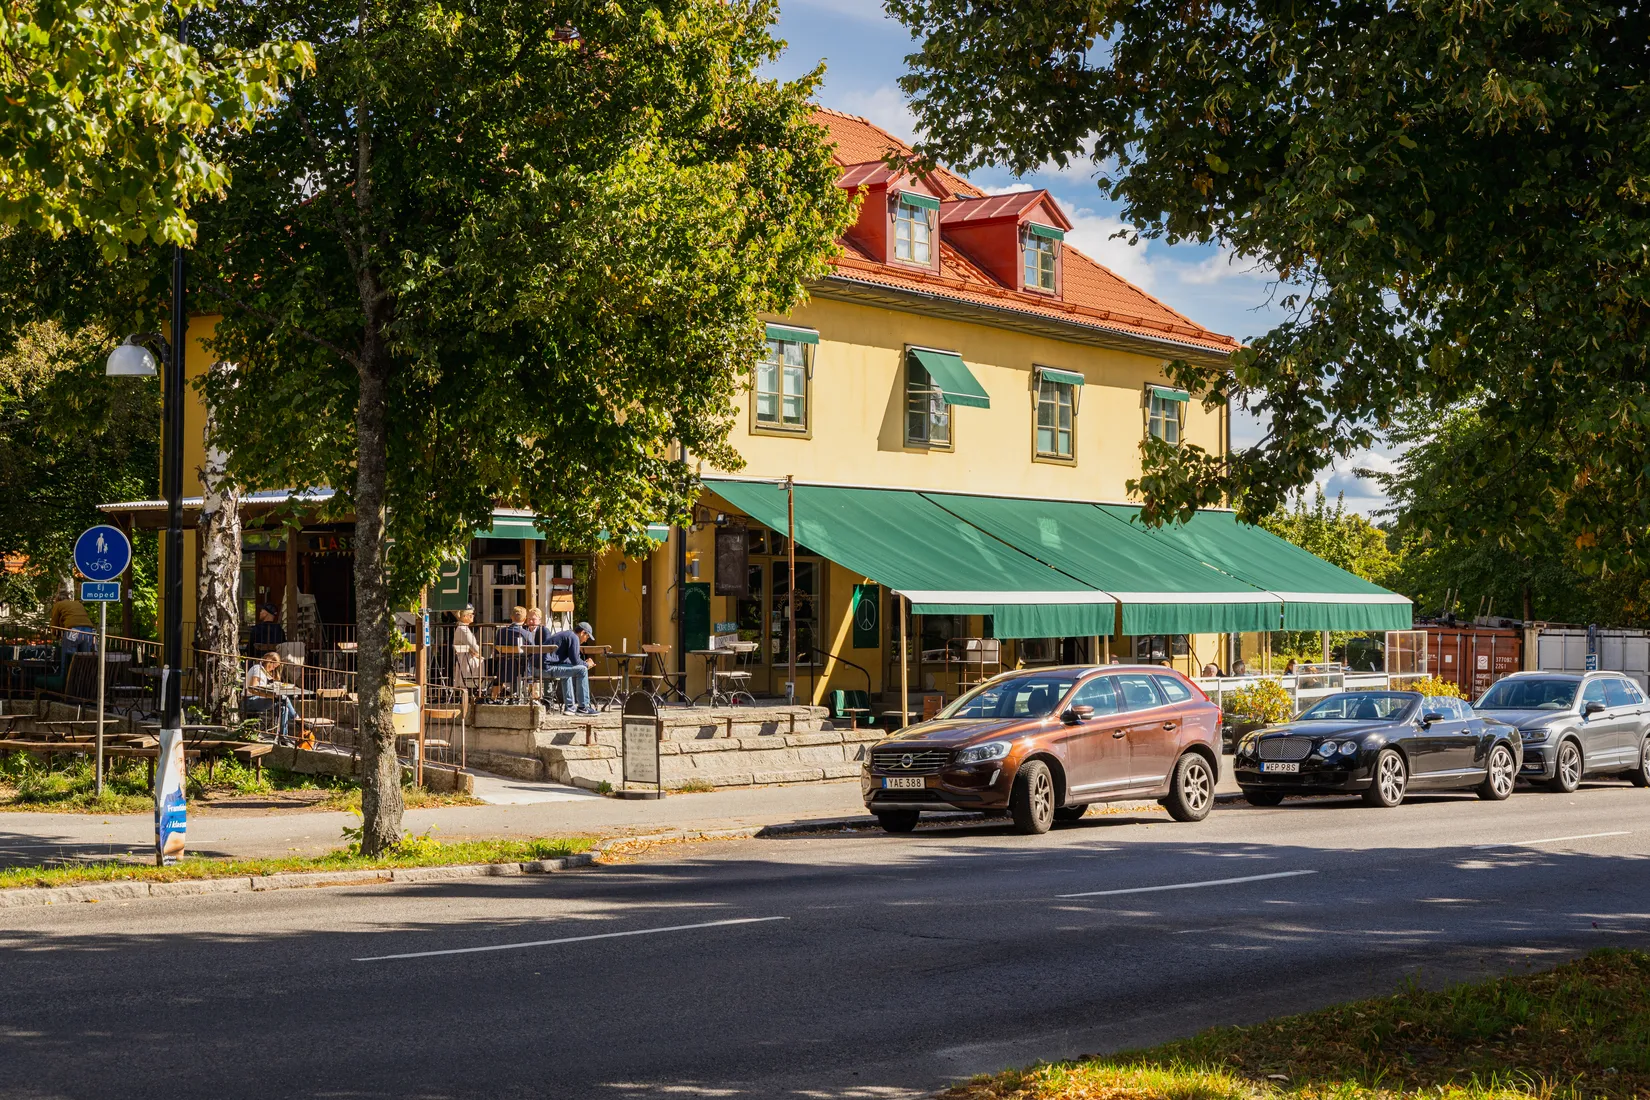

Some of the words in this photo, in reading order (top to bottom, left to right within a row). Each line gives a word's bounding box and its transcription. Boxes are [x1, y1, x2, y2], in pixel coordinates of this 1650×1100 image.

[97, 584, 105, 592] Ej
[1265, 763, 1279, 771] WEP
[888, 778, 904, 787] YAE
[905, 778, 922, 787] 388
